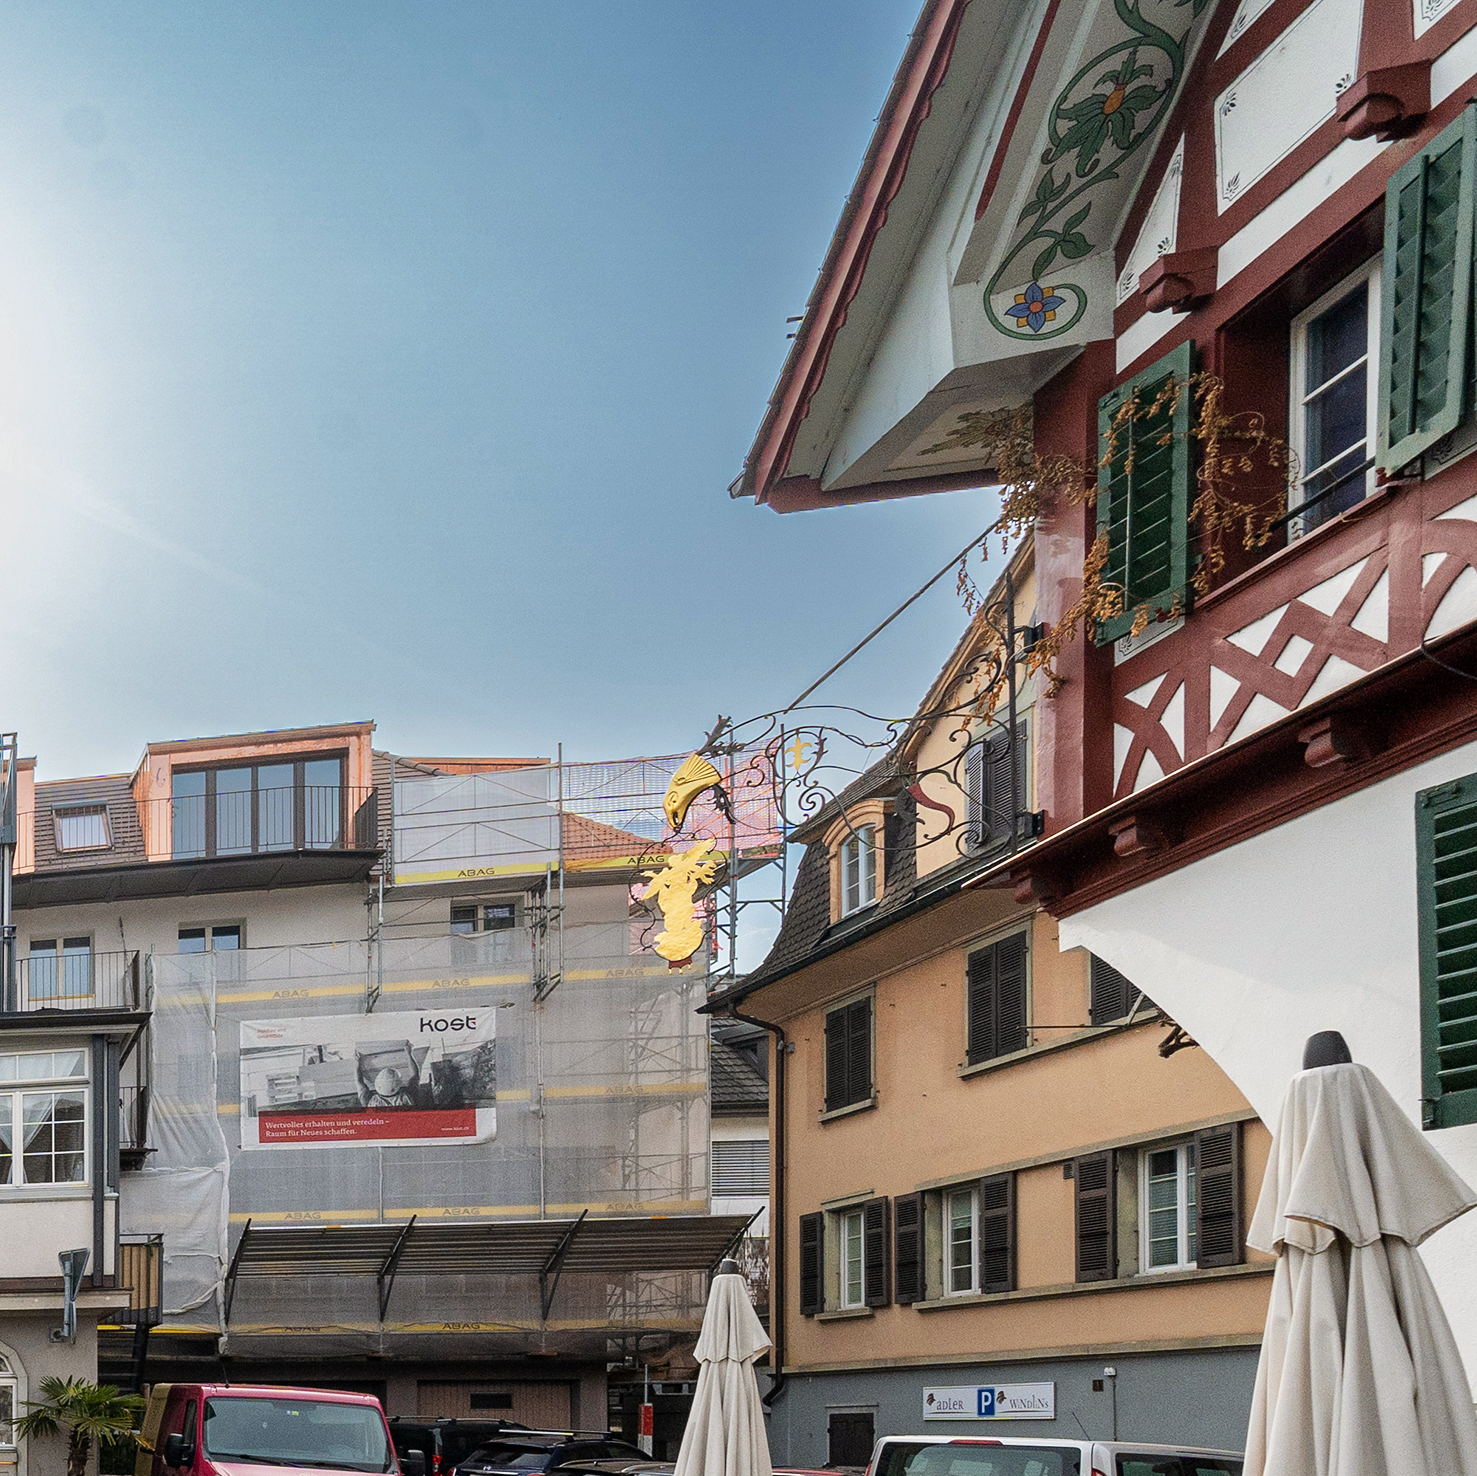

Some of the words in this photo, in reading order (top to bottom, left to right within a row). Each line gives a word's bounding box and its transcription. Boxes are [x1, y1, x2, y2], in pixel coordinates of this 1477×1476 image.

[627, 855, 665, 865] ABAG
[457, 867, 495, 878] ABAG
[606, 968, 644, 978] ABAG
[432, 978, 470, 989] ABAG
[273, 989, 310, 999] ABAG
[265, 1121, 304, 1129] Wertvolles
[352, 1118, 384, 1126] veredeln
[324, 1128, 357, 1136] schaffen.
[284, 1211, 322, 1220] ABAG
[442, 1207, 480, 1217] ABAG
[442, 1322, 480, 1330] ABAG
